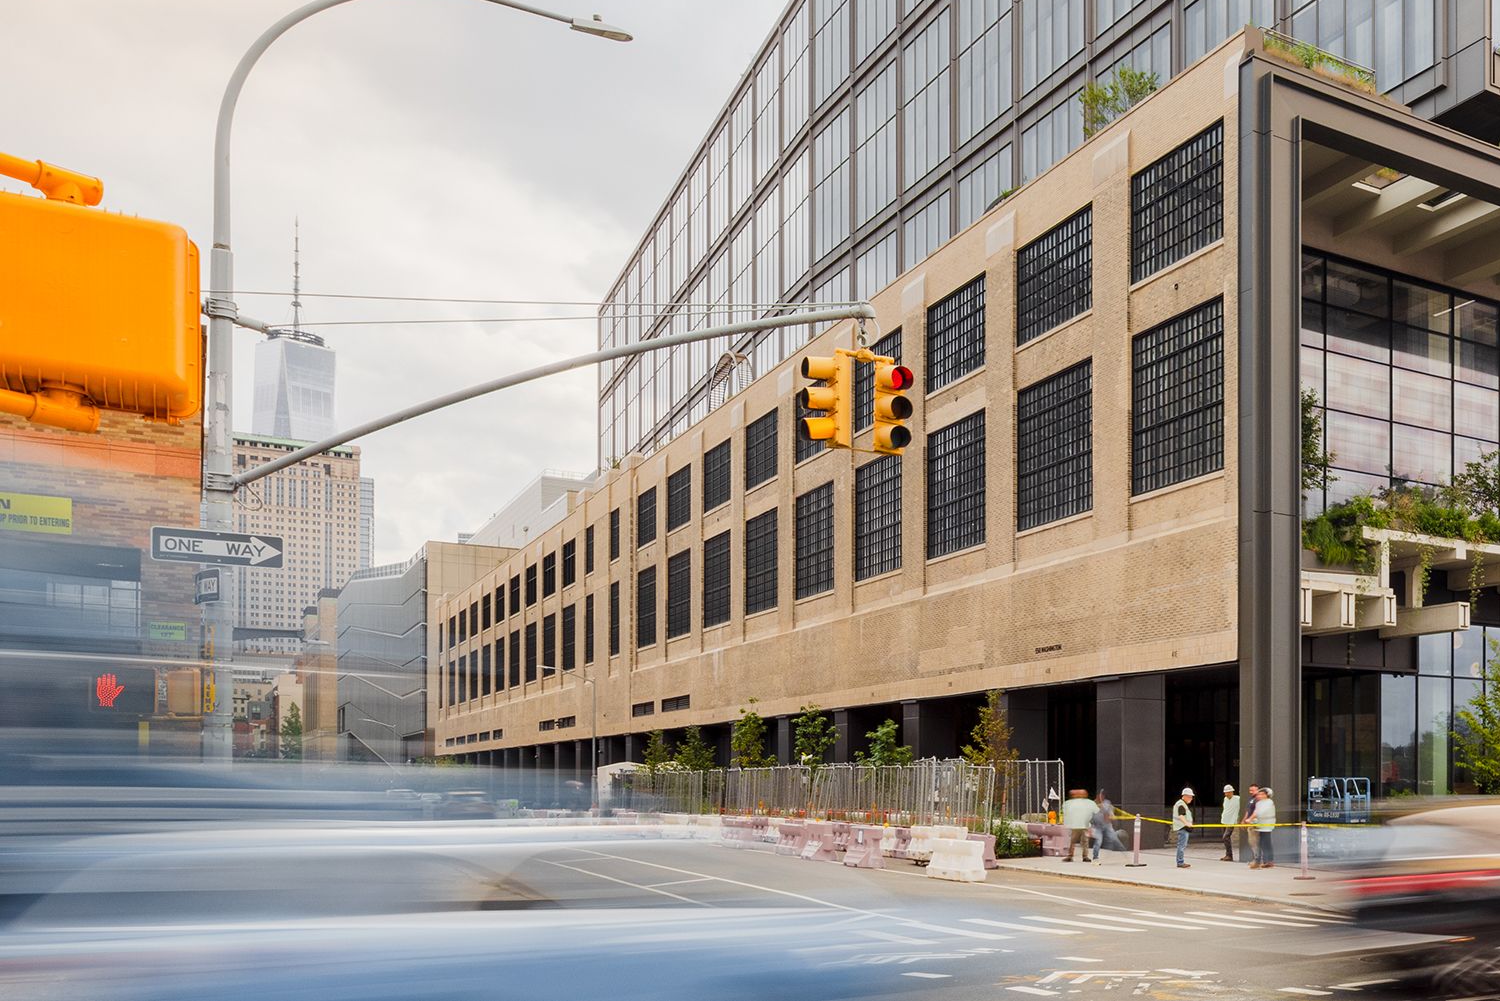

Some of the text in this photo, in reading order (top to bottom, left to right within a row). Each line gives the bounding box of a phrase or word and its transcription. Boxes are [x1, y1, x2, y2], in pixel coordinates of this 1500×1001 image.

[30, 515, 38, 525] TO
[39, 517, 70, 528] ENTERING
[164, 538, 266, 557] ONE WAY
